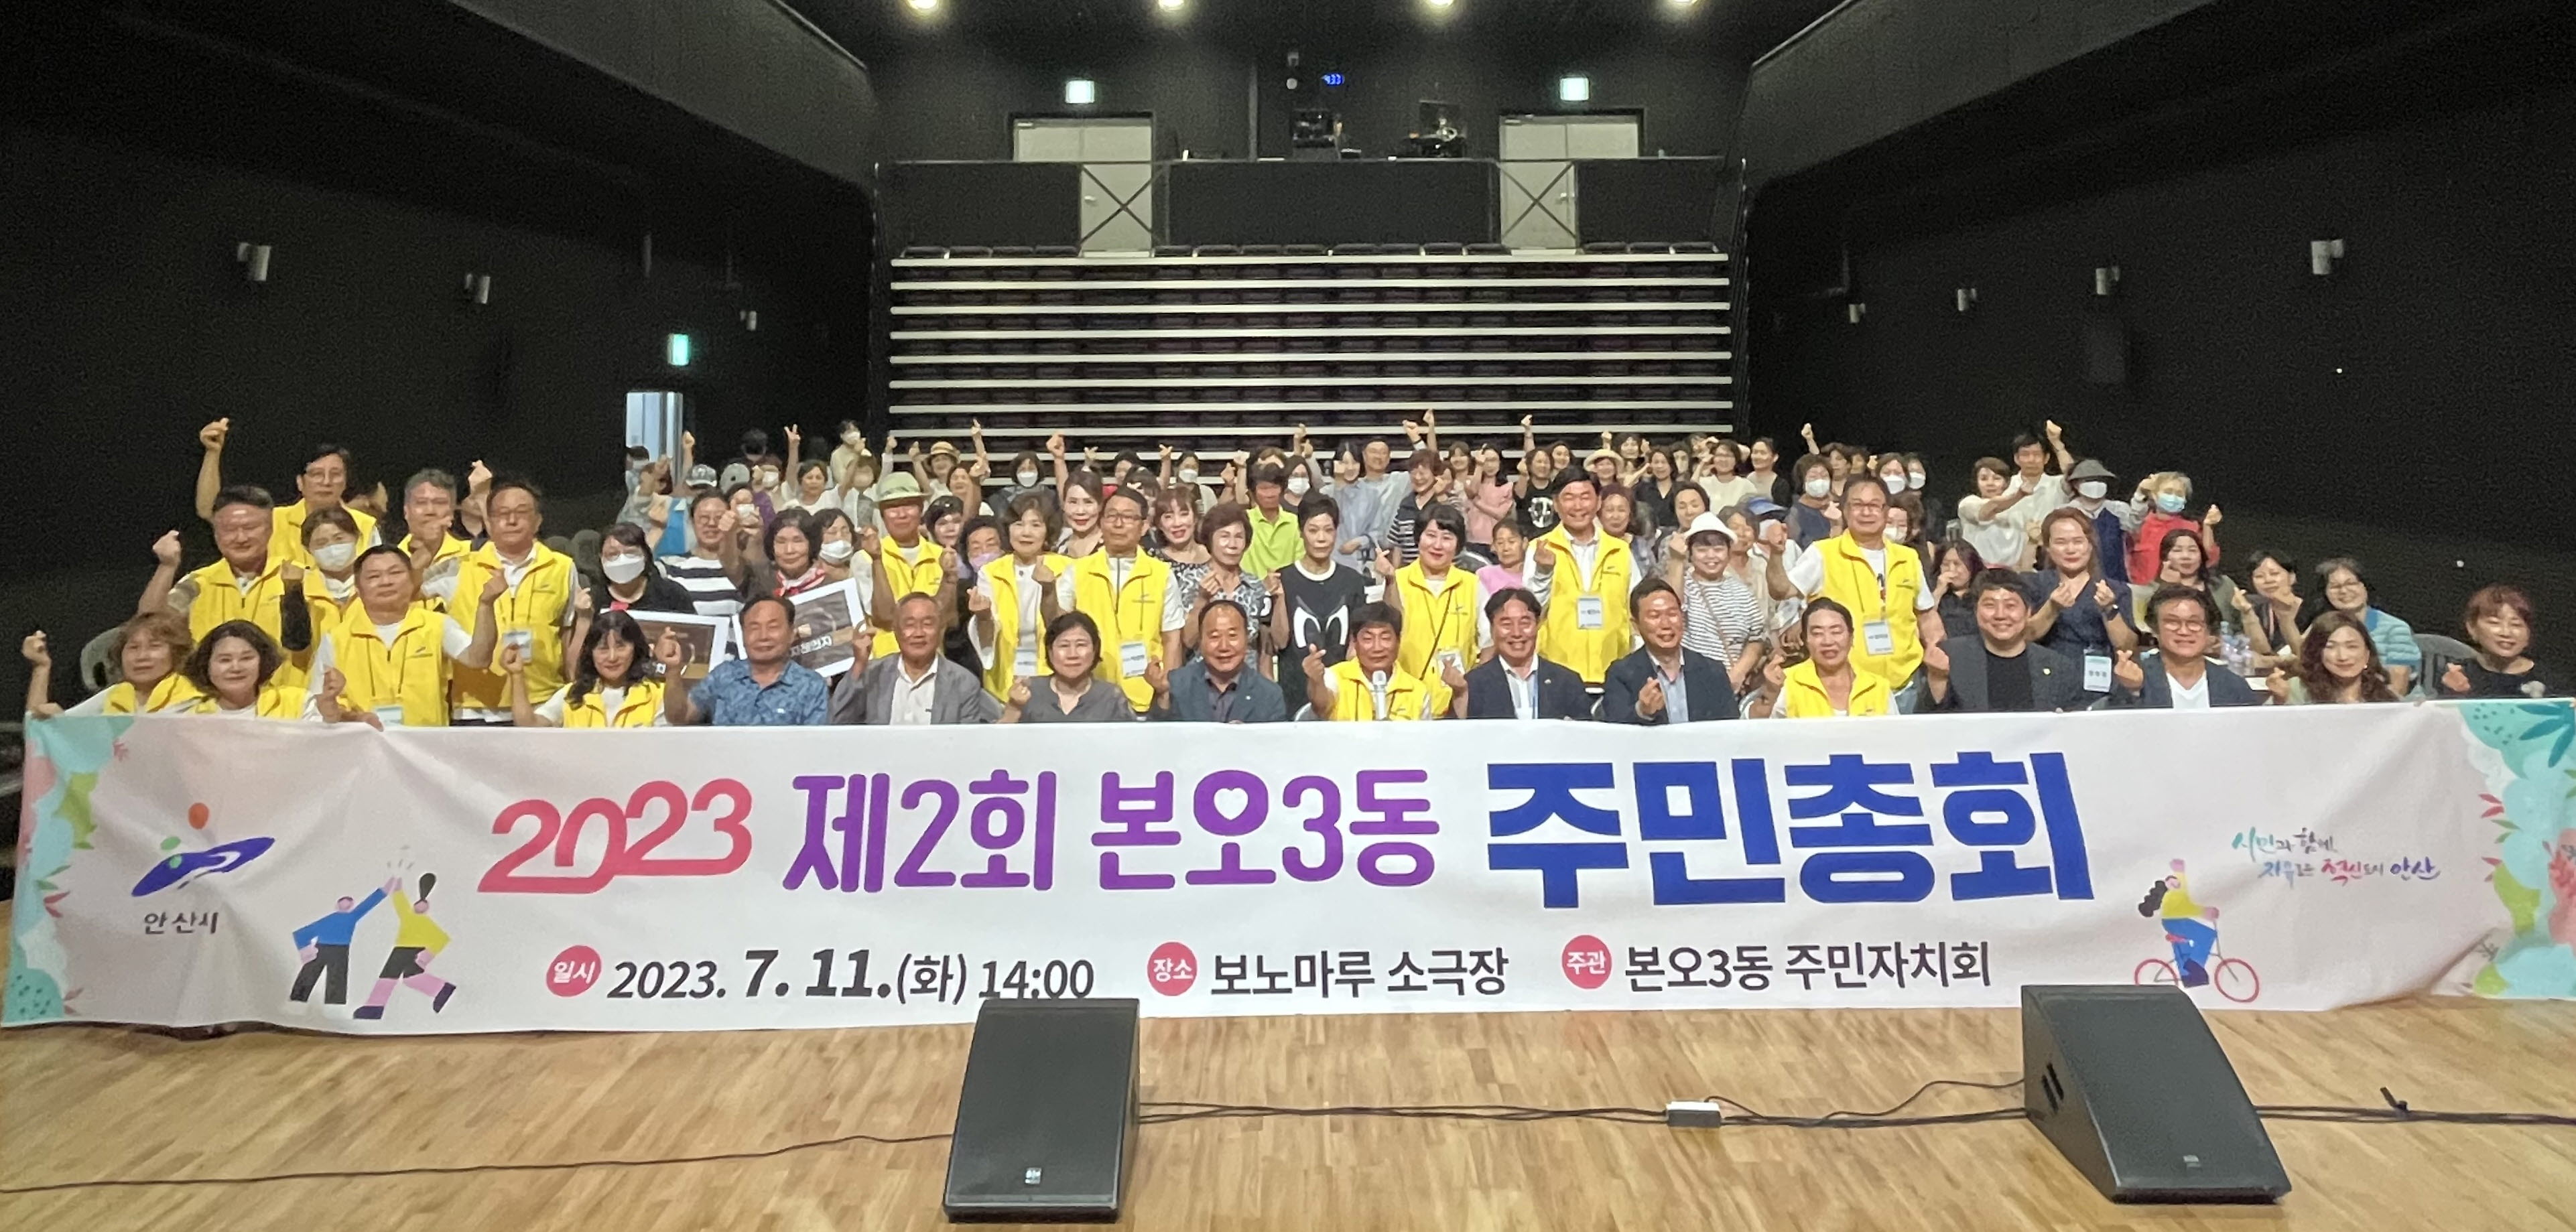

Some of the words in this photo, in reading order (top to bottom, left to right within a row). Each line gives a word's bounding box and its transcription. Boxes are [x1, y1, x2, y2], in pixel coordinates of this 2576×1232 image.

[480, 779, 753, 894] 2023
[783, 770, 1057, 892] 제2회
[1092, 770, 1439, 890] 본오3동
[1487, 751, 2094, 908] 주민총회
[2390, 856, 2441, 881] 안산
[143, 912, 219, 935] 안산시
[554, 961, 595, 983] 일시
[607, 961, 726, 999] 2023.
[745, 950, 789, 998] 7.
[978, 959, 1094, 999] 14:00
[1153, 957, 1193, 982] 장소
[1211, 951, 1375, 999] 보노마루
[1387, 947, 1509, 996] 소극장
[1567, 950, 1606, 975] 주관
[1625, 946, 1773, 993] 본오3동
[1785, 941, 1991, 990] 주민자치회
